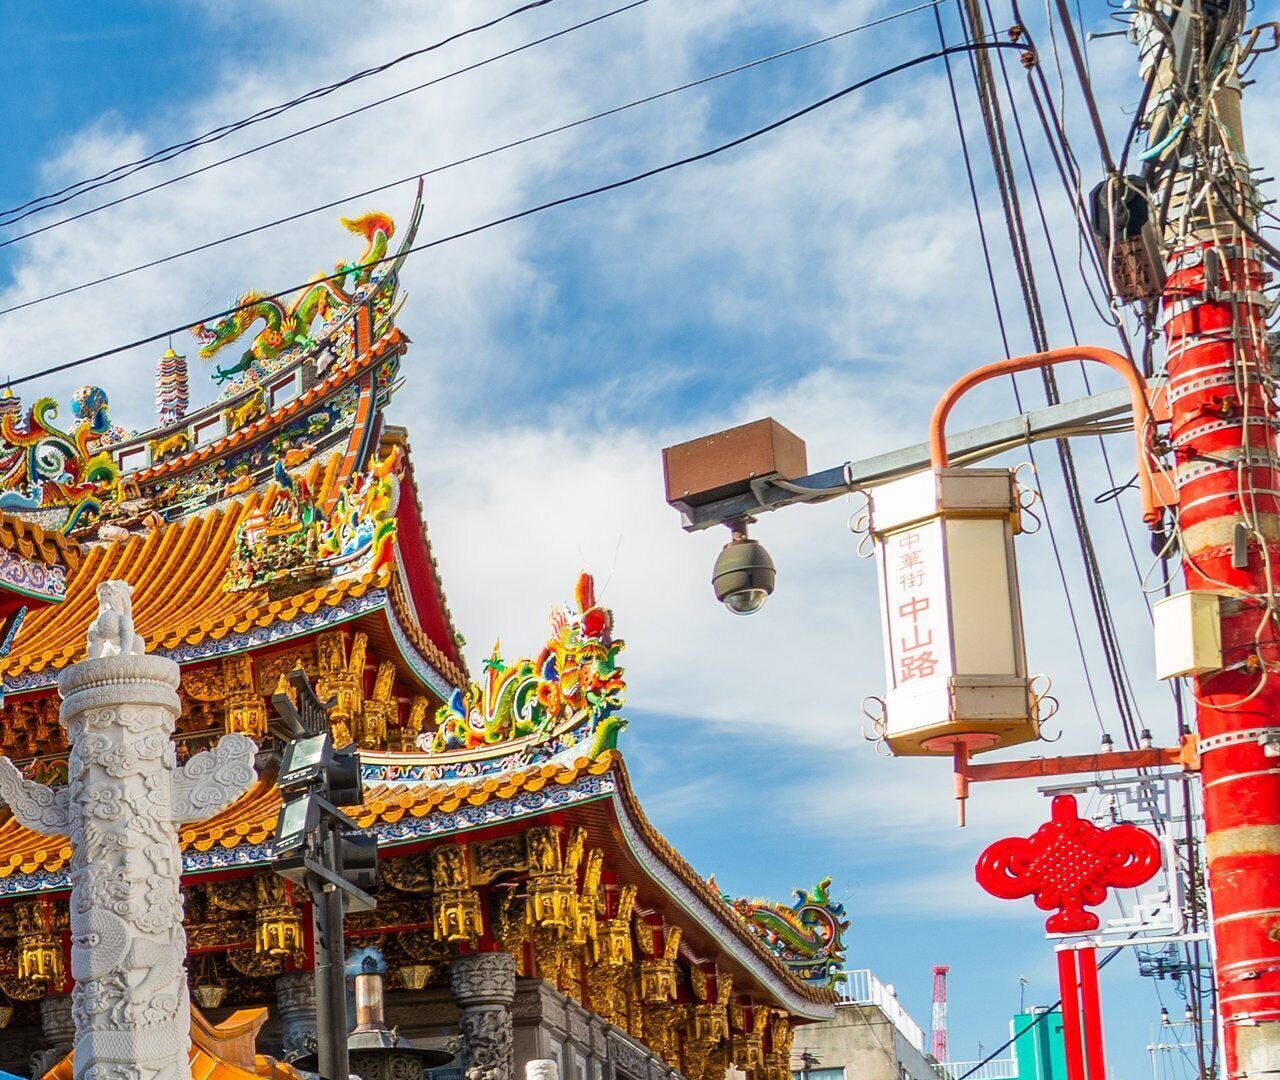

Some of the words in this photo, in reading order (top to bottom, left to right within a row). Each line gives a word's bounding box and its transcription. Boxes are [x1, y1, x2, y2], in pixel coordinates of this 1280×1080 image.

[899, 532, 925, 591] 中華街
[899, 596, 939, 683] 中山路
